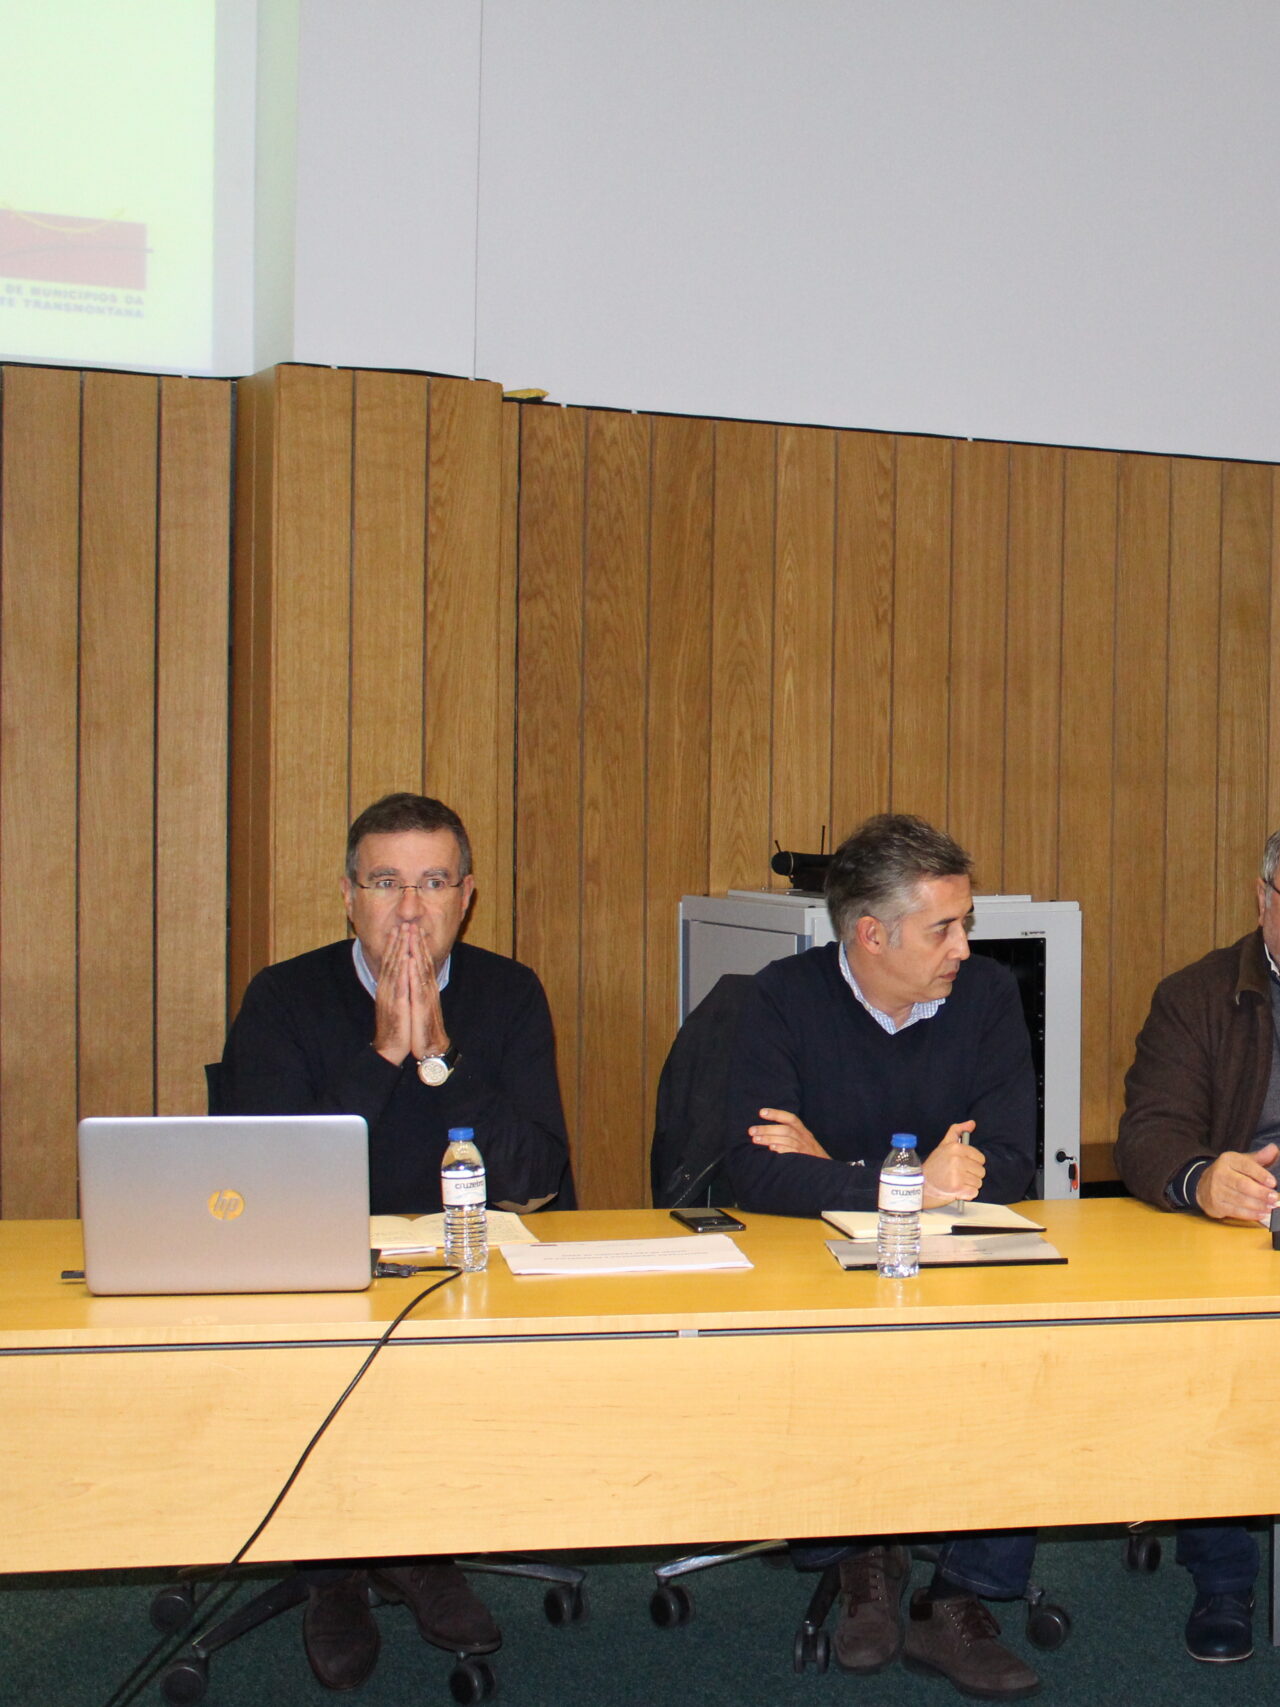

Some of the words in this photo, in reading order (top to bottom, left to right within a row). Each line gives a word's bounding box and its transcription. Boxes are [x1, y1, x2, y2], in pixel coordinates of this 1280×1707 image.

[5, 283, 23, 296] DE
[125, 294, 144, 305] DA
[24, 298, 145, 318] TRANSMONTANA
[211, 1189, 241, 1221] hp
